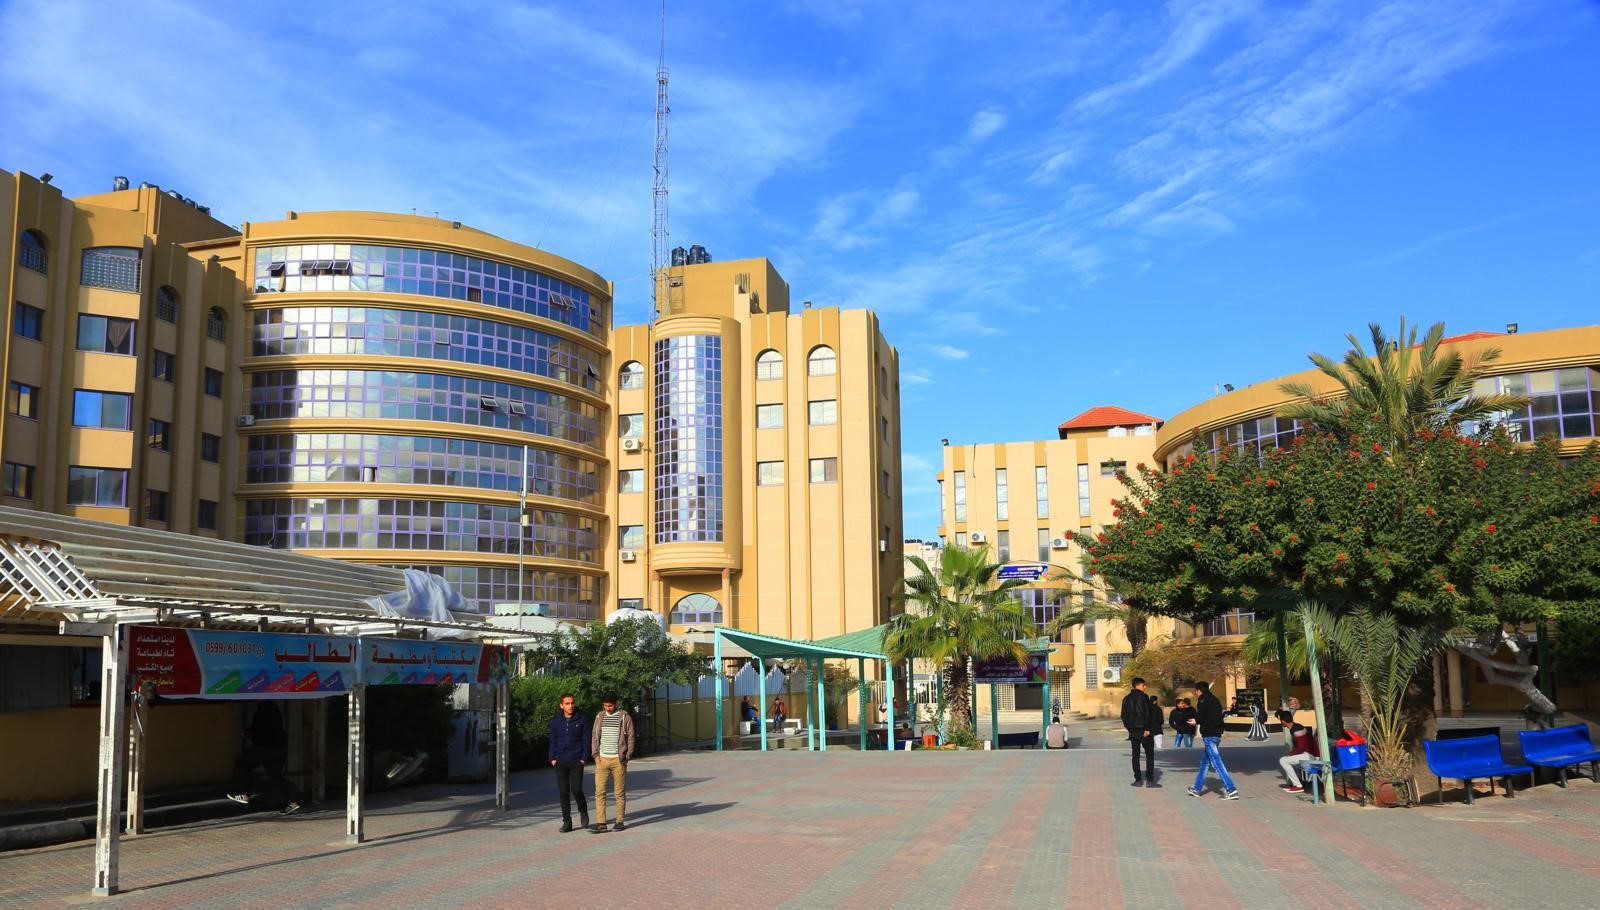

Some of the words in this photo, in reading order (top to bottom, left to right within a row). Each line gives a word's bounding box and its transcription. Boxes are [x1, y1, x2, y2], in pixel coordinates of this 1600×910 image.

[275, 641, 356, 669] الطالب
[371, 644, 432, 669] ومطبعة
[432, 647, 476, 669] مكتبة
